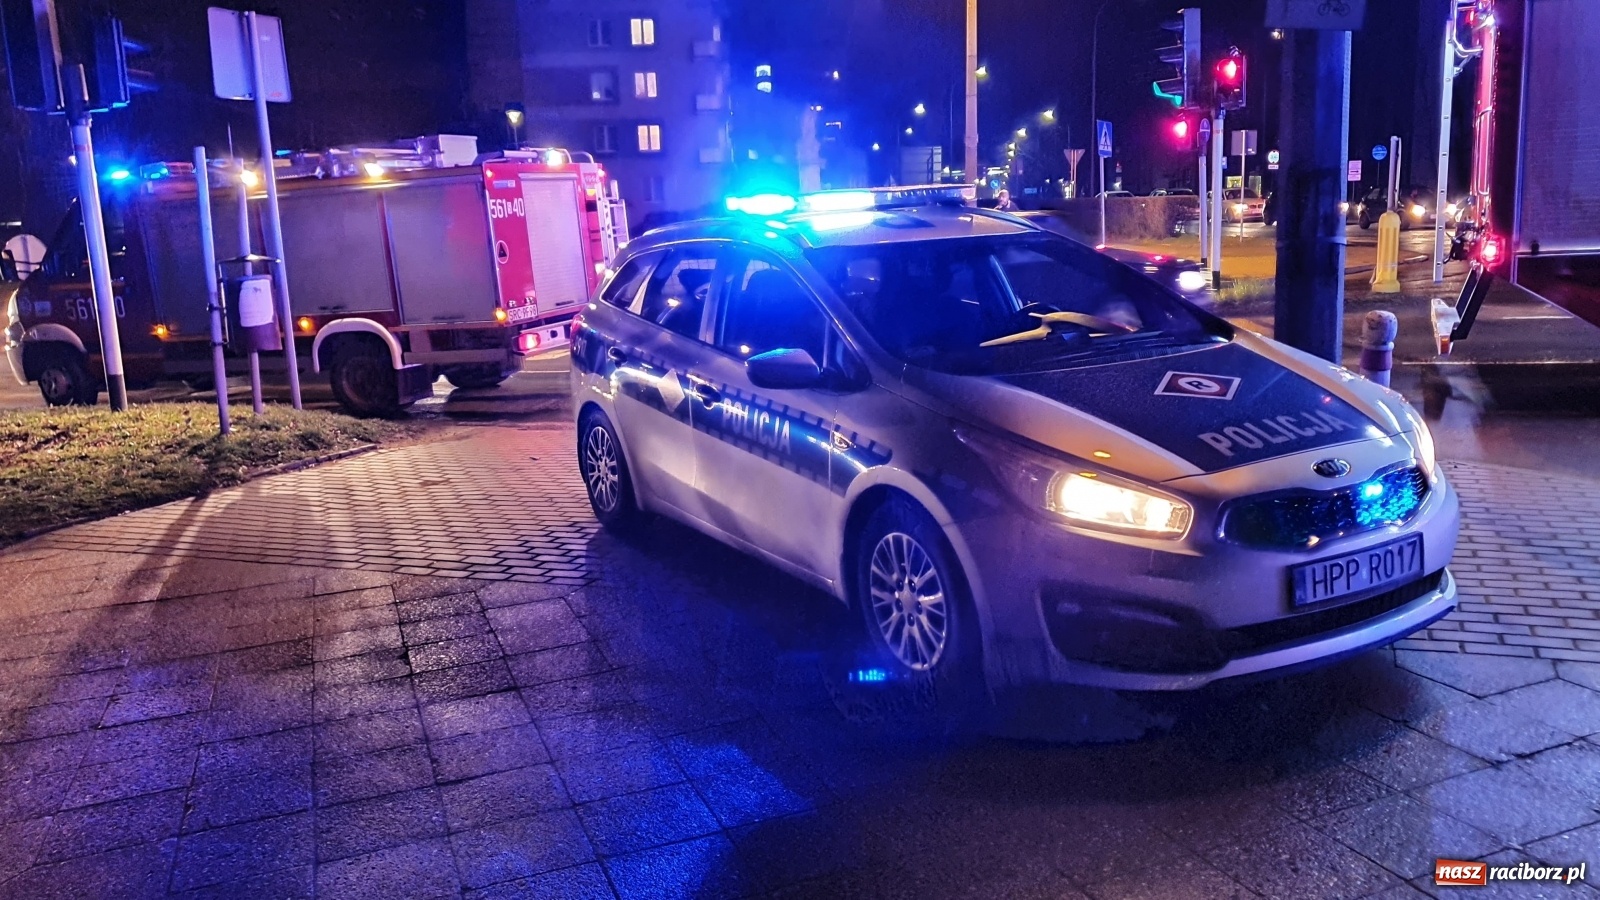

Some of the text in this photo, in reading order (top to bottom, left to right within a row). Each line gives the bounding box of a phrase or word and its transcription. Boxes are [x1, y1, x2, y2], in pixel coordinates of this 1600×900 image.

[1185, 380, 1212, 390] R
[723, 397, 791, 455] POLICJA
[1197, 409, 1357, 457] POLICJA
[1311, 540, 1418, 599] HPP R017
